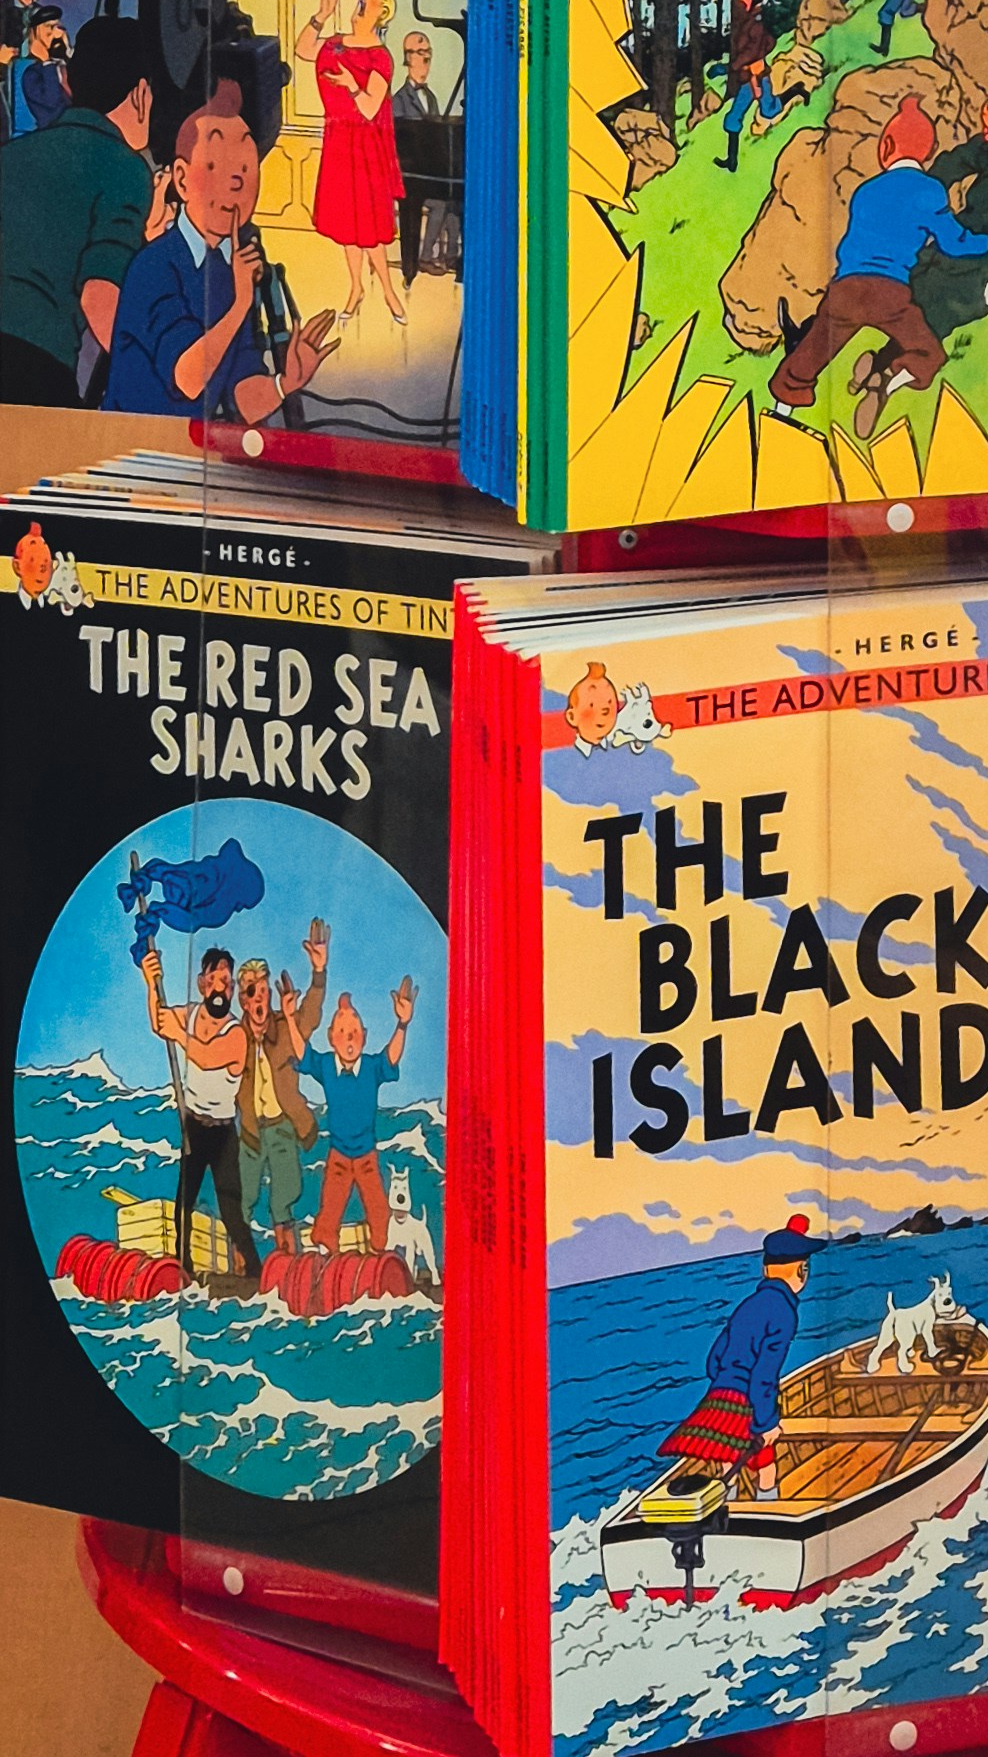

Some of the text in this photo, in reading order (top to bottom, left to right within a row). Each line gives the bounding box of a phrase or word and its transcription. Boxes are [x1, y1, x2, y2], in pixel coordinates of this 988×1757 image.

[219, 543, 297, 568] HERGÉ
[95, 570, 455, 634] THE ADVENTURES OF TIN
[854, 624, 959, 656] HERGÉ
[79, 625, 441, 737] THE RED SEA
[686, 687, 758, 726] THE
[150, 705, 372, 801] SHARKS
[583, 791, 789, 920] THE
